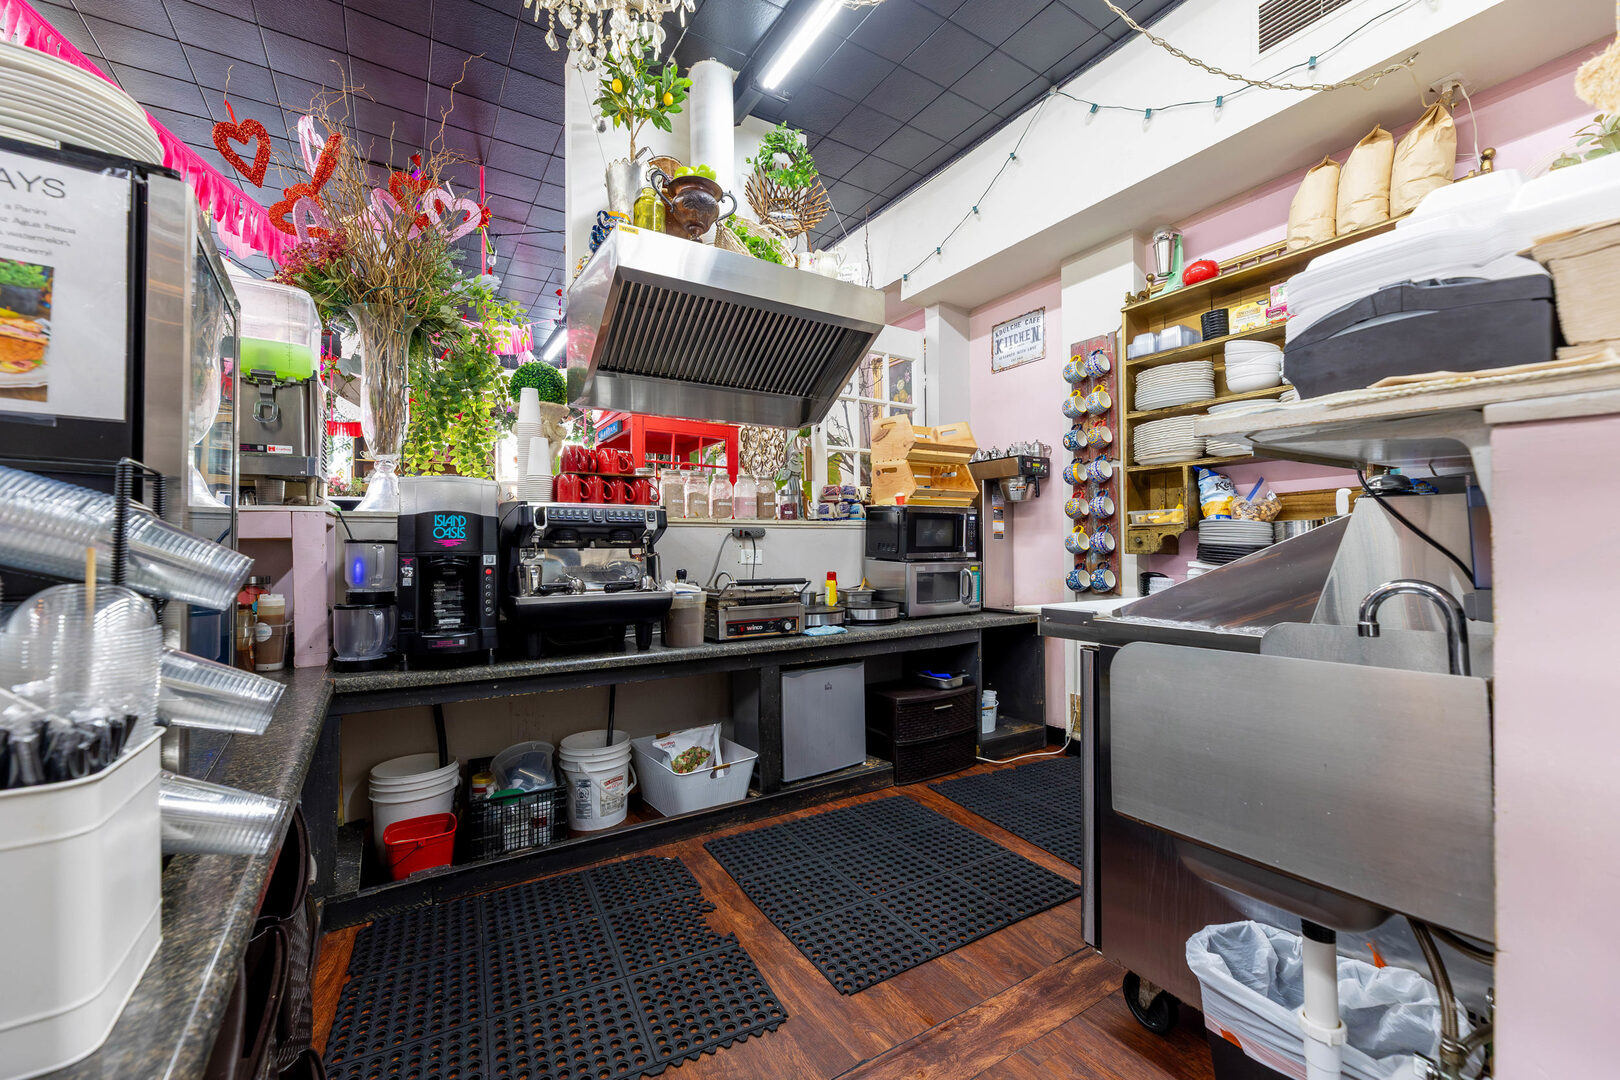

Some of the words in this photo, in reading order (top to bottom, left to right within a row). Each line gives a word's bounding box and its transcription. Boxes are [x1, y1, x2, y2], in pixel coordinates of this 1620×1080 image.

[995, 325, 1041, 355] KITCHEN
[434, 514, 467, 527] ISLAND
[433, 526, 467, 539] OASIS
